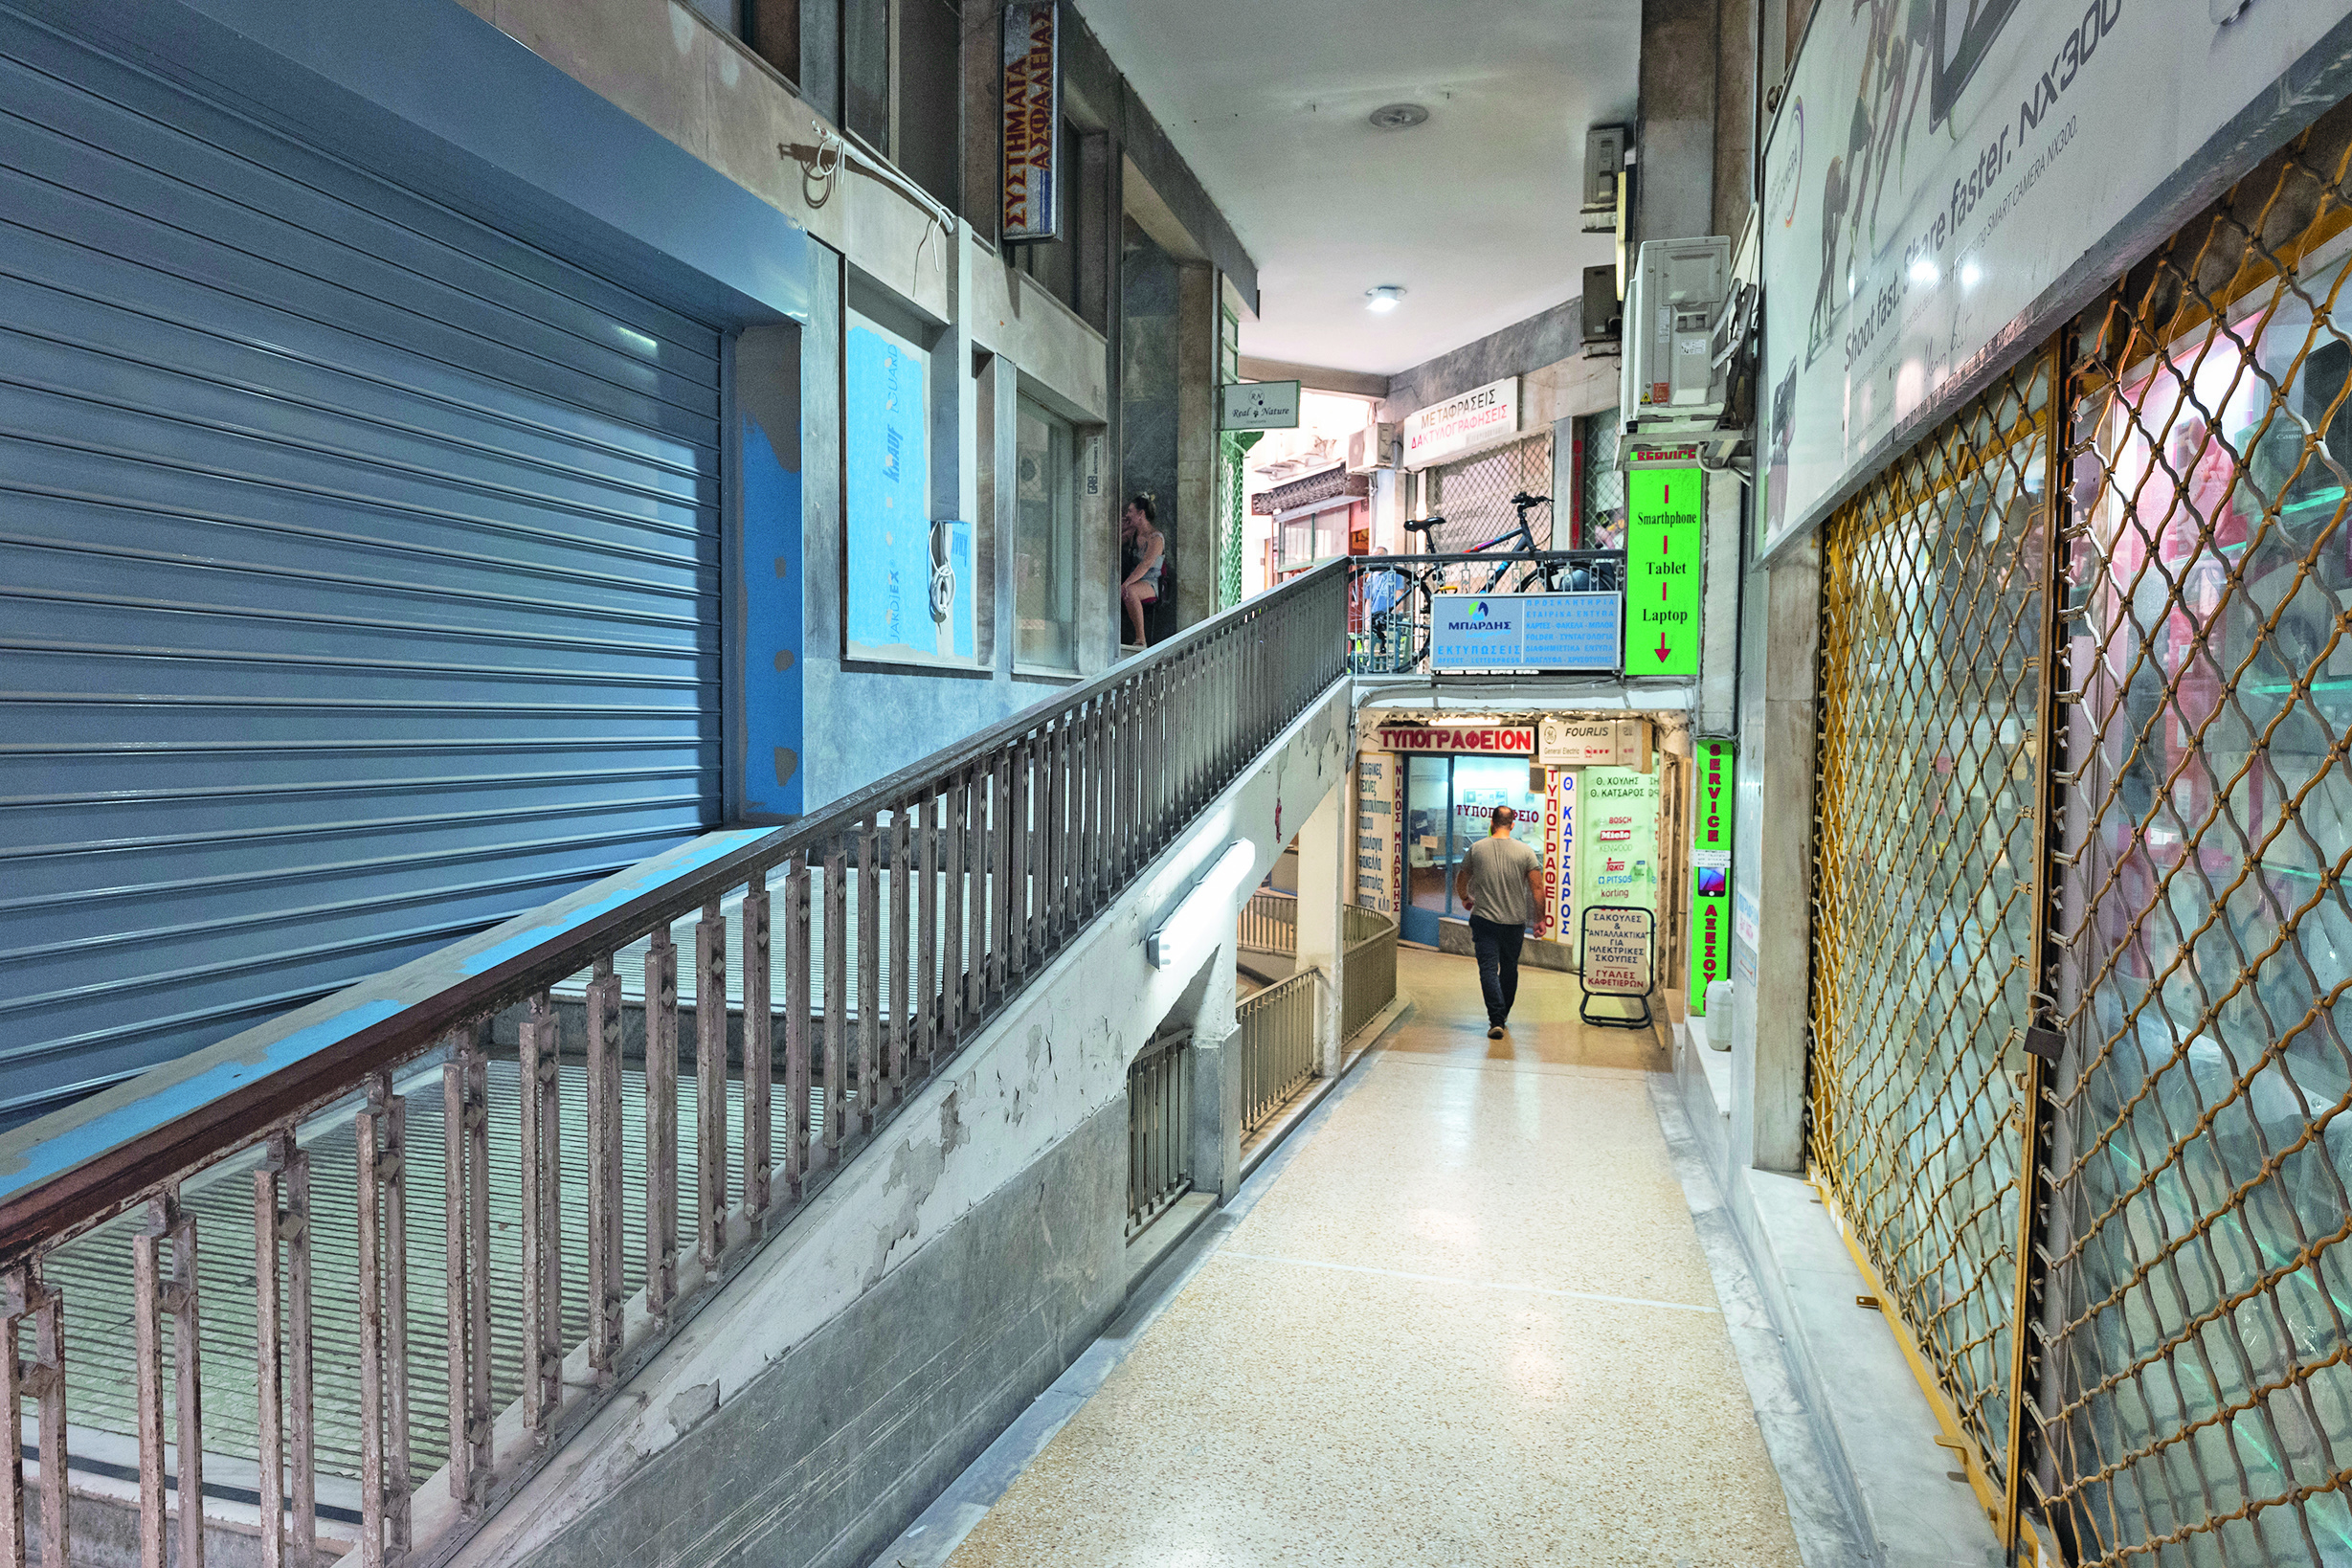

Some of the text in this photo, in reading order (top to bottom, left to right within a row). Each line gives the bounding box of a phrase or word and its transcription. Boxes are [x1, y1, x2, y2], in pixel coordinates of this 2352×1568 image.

[1029, 6, 1052, 171] ΑΣΦΑΛΕΙΑΣ
[1005, 56, 1028, 229] ΣΥΣΤΗΜΑΤΑ
[2012, 153, 2046, 207] CAMERA
[1844, 303, 1875, 373] Shoot
[1877, 268, 1900, 333] fast.
[1951, 123, 2011, 236] faster.
[1233, 407, 1289, 417] Real Nature
[1421, 388, 1495, 430] ΜΕΤΑΦΡΑΣΕΙΣ
[1411, 404, 1508, 449] ΔΑΚΤΥΛΟΓΡΑΦΗΣΕΙΣ
[1638, 511, 1696, 527] Smarthphone
[1646, 562, 1686, 575] Tablet
[1643, 609, 1688, 624] Laptop
[1448, 621, 1512, 630] ΜΠΑΡΔΗΣ
[1438, 645, 1520, 655] ΕΚΤΥΠΩΣΕΙΣ
[1380, 728, 1531, 750] ΤΥΠΟΓΡΑΦΕΙΟΝ
[1565, 728, 1609, 737] FOURLIS
[1607, 776, 1639, 785] ΧΟΥΛΗΣ
[1602, 789, 1645, 797] ΚΑΤΣΑΡΟΣ
[1708, 744, 1721, 842] SERVICE
[1456, 804, 1539, 823] ΤΥΠΟΓΦΕΙΟ
[1601, 831, 1630, 840] Miele
[1393, 831, 1401, 912] ΜΠΑΡΔΗΣ
[1560, 806, 1573, 935] ΚΑΤΣΑΡΟΣ
[1606, 875, 1632, 885] PITSOS
[1594, 913, 1642, 923] ΣΑΚΟΥΛΕΣ
[1589, 930, 1646, 939] ΑΝΤΑΛΛΑΚΤΙΚΑ
[1589, 946, 1644, 955] ΗΛΕΚΤΡΙΚΕΣ
[1595, 954, 1638, 964] ΣΚΟΥΠΕΣ
[1702, 905, 1717, 1012] ΑΞΕΣΟΥ
[1596, 970, 1635, 979] ΓΥΑΛΕΣ
[1588, 977, 1644, 988] ΚΑΦΕΤΙΕΡΩΝ
